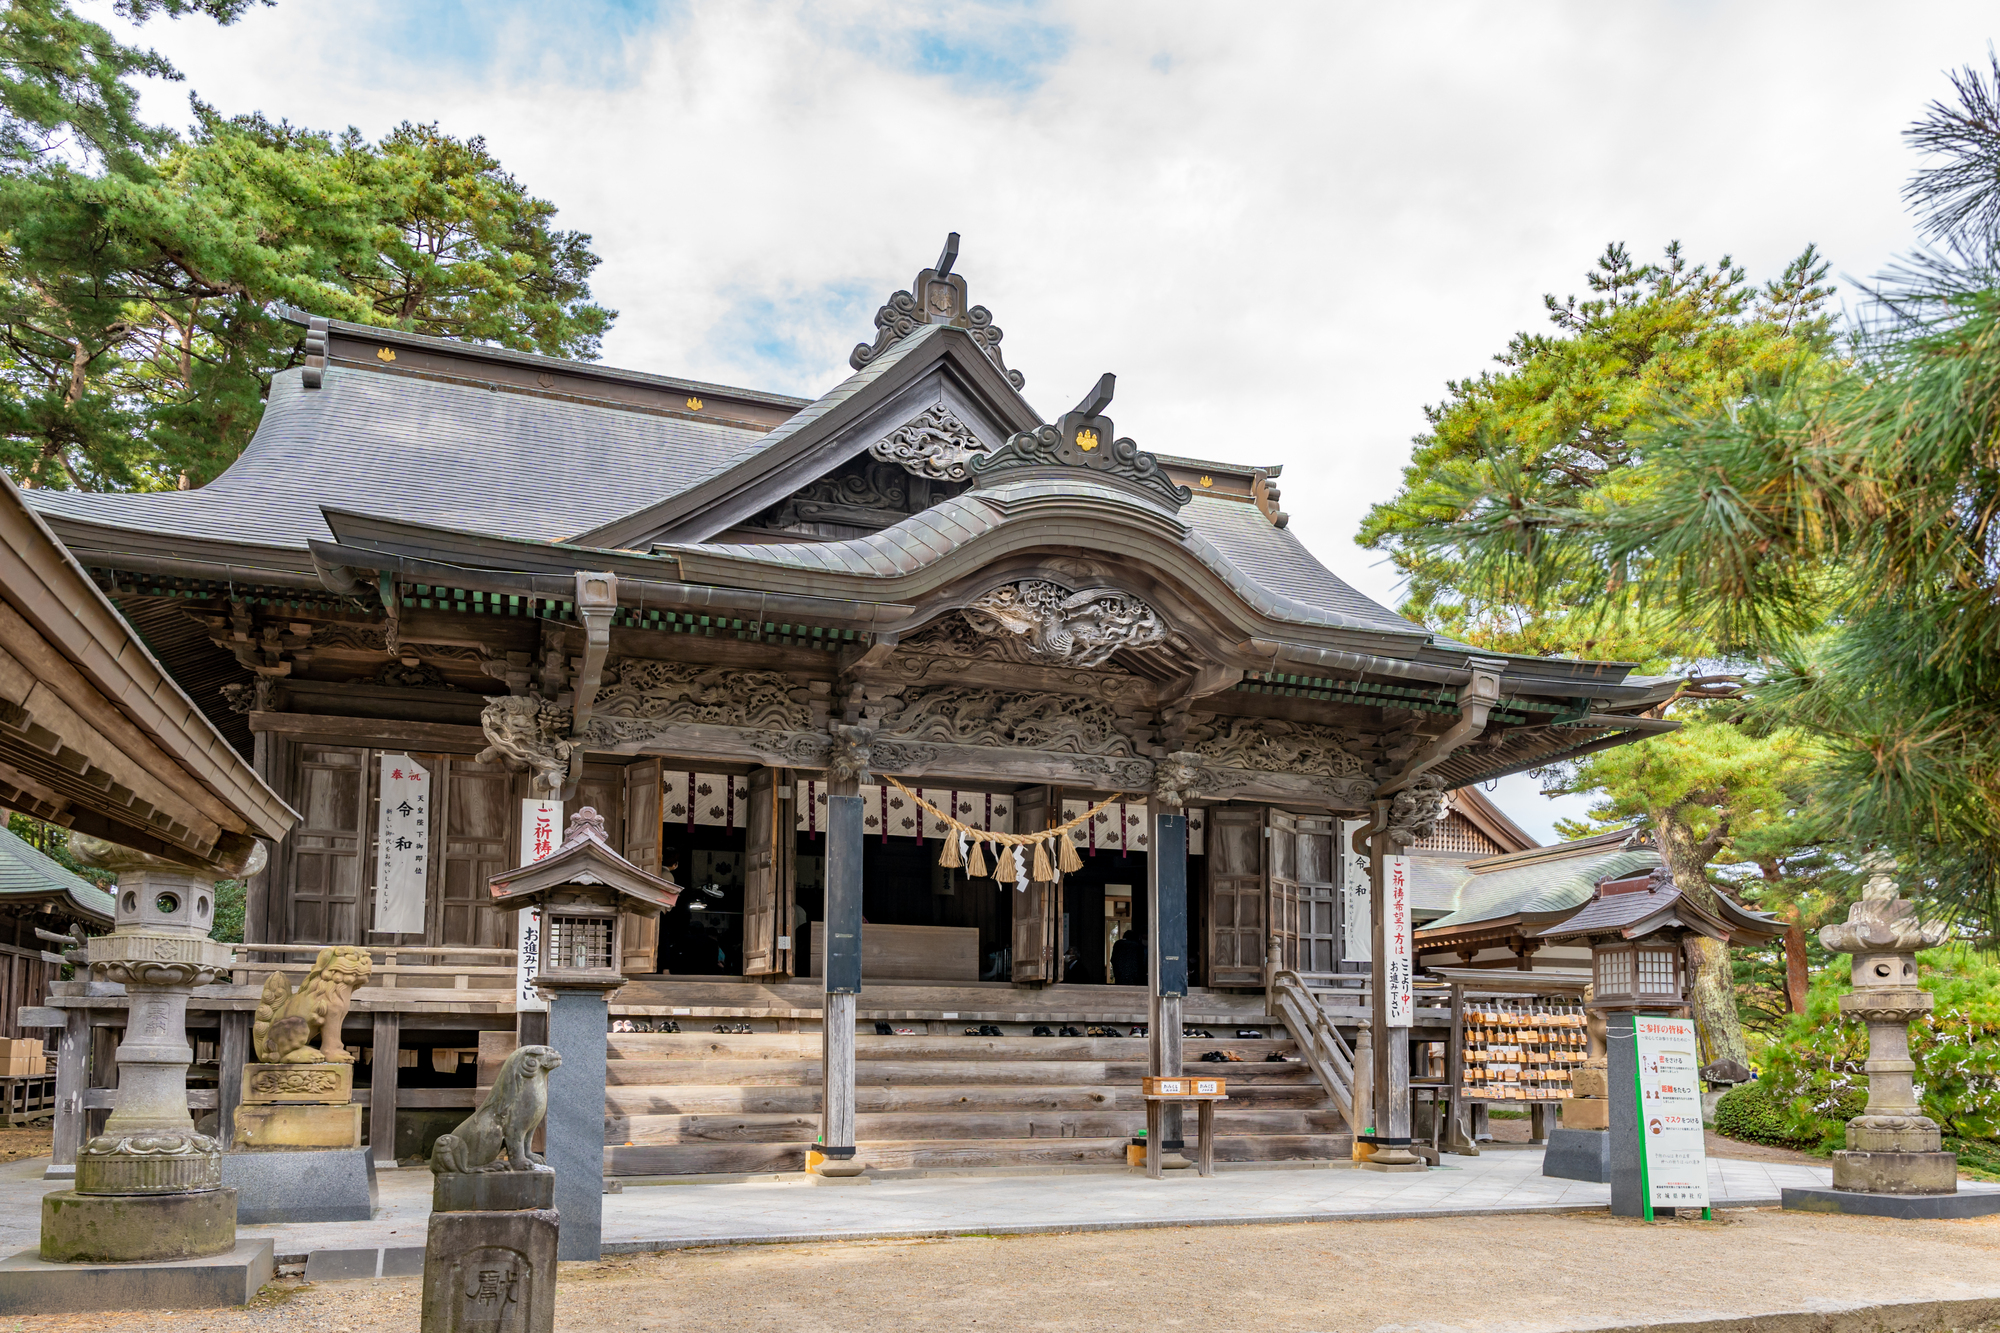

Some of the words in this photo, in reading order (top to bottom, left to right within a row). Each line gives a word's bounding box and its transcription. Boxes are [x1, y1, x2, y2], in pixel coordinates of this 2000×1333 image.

[395, 801, 414, 851] 令和
[414, 794, 425, 875] 天皇陛下御即位
[383, 809, 392, 911] 新しい御代をお祝いしましょう
[1354, 856, 1367, 897] 令和
[1392, 862, 1405, 954] ご祈祷希望の方は
[522, 926, 540, 1001] お進み下さい
[1390, 961, 1400, 1018] お進み下さい
[1401, 958, 1410, 1014] ここより中に
[1638, 1023, 1692, 1035] ご参拝の皆様へ
[1664, 1116, 1699, 1125] マスクをつける
